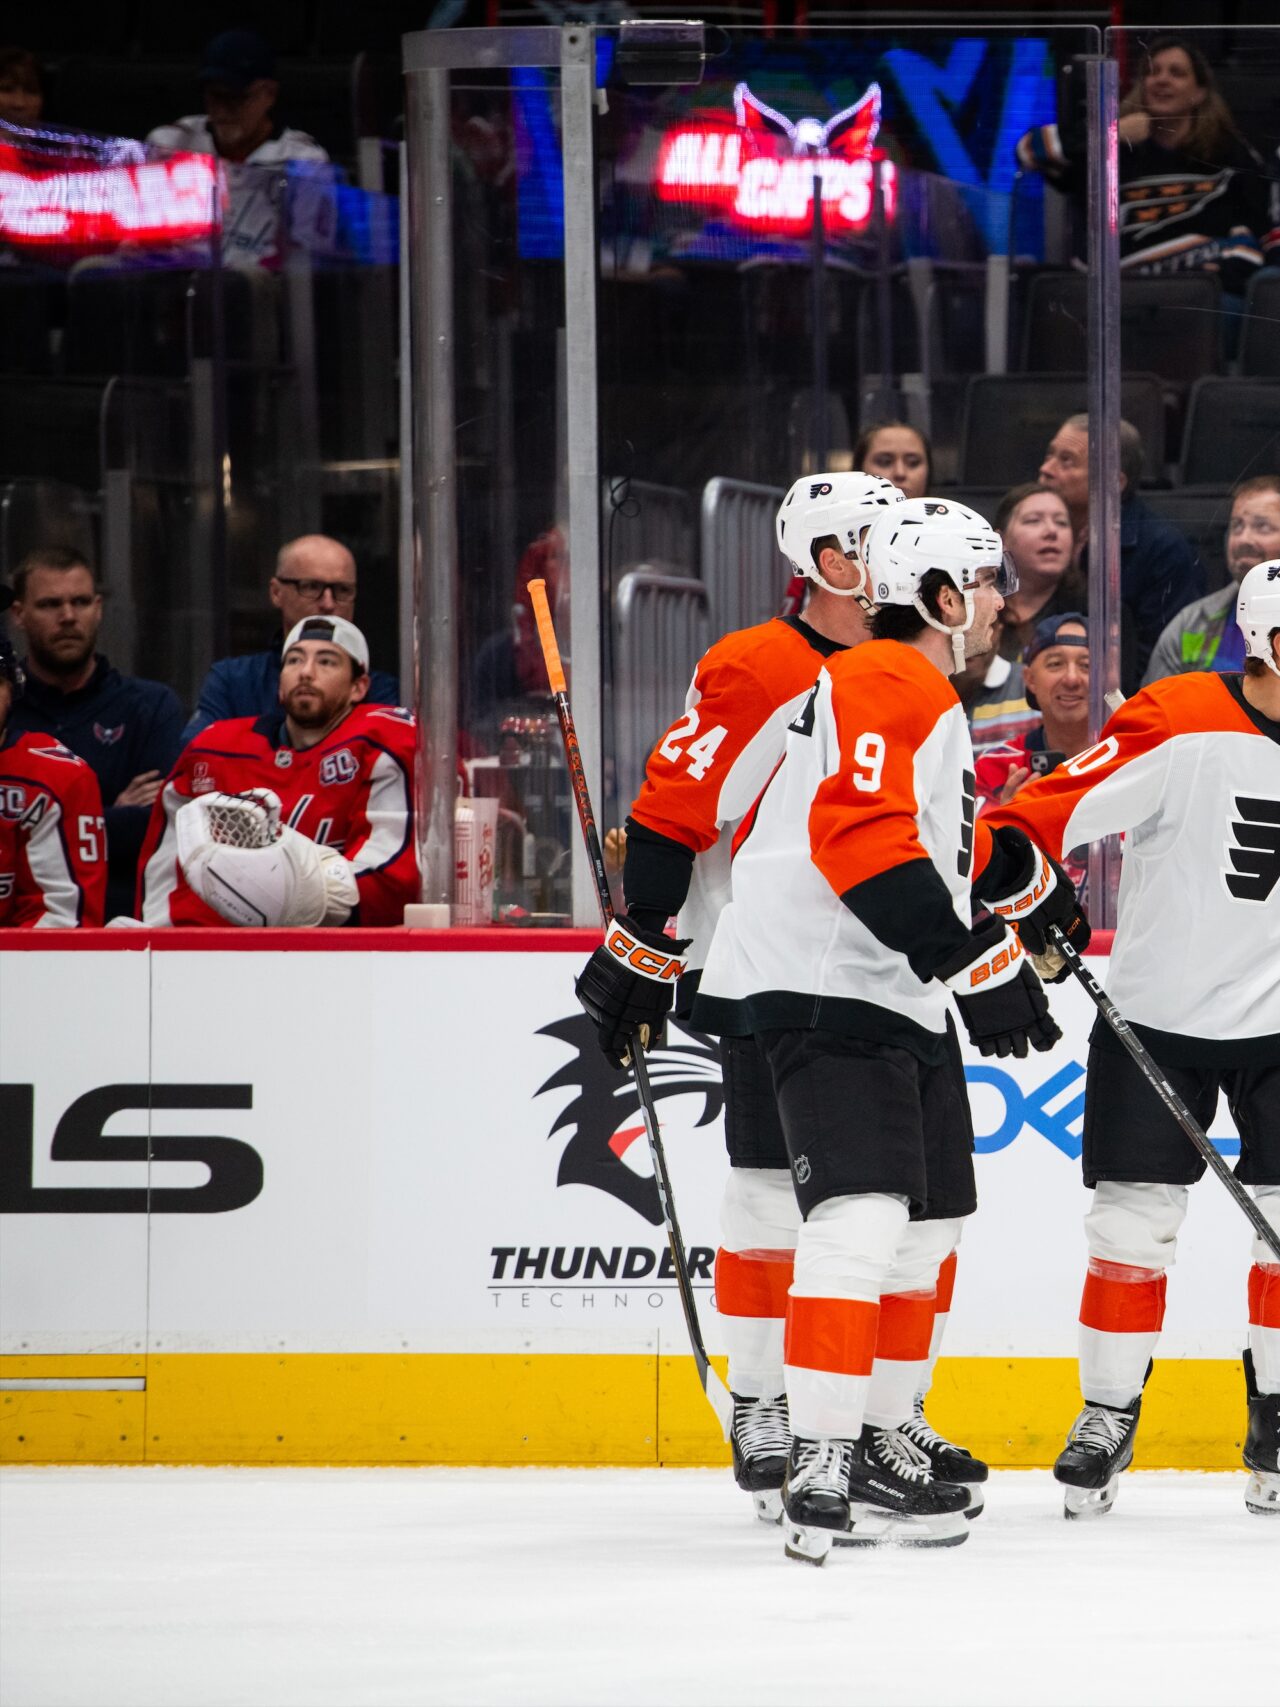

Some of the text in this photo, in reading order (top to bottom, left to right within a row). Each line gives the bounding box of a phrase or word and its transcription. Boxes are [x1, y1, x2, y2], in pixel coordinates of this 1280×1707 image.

[663, 133, 742, 185] ALL
[658, 707, 729, 782] 24
[852, 731, 887, 793] 9
[19, 792, 50, 831] A
[490, 1246, 716, 1280] THUNDER
[867, 1479, 906, 1499] BAUER
